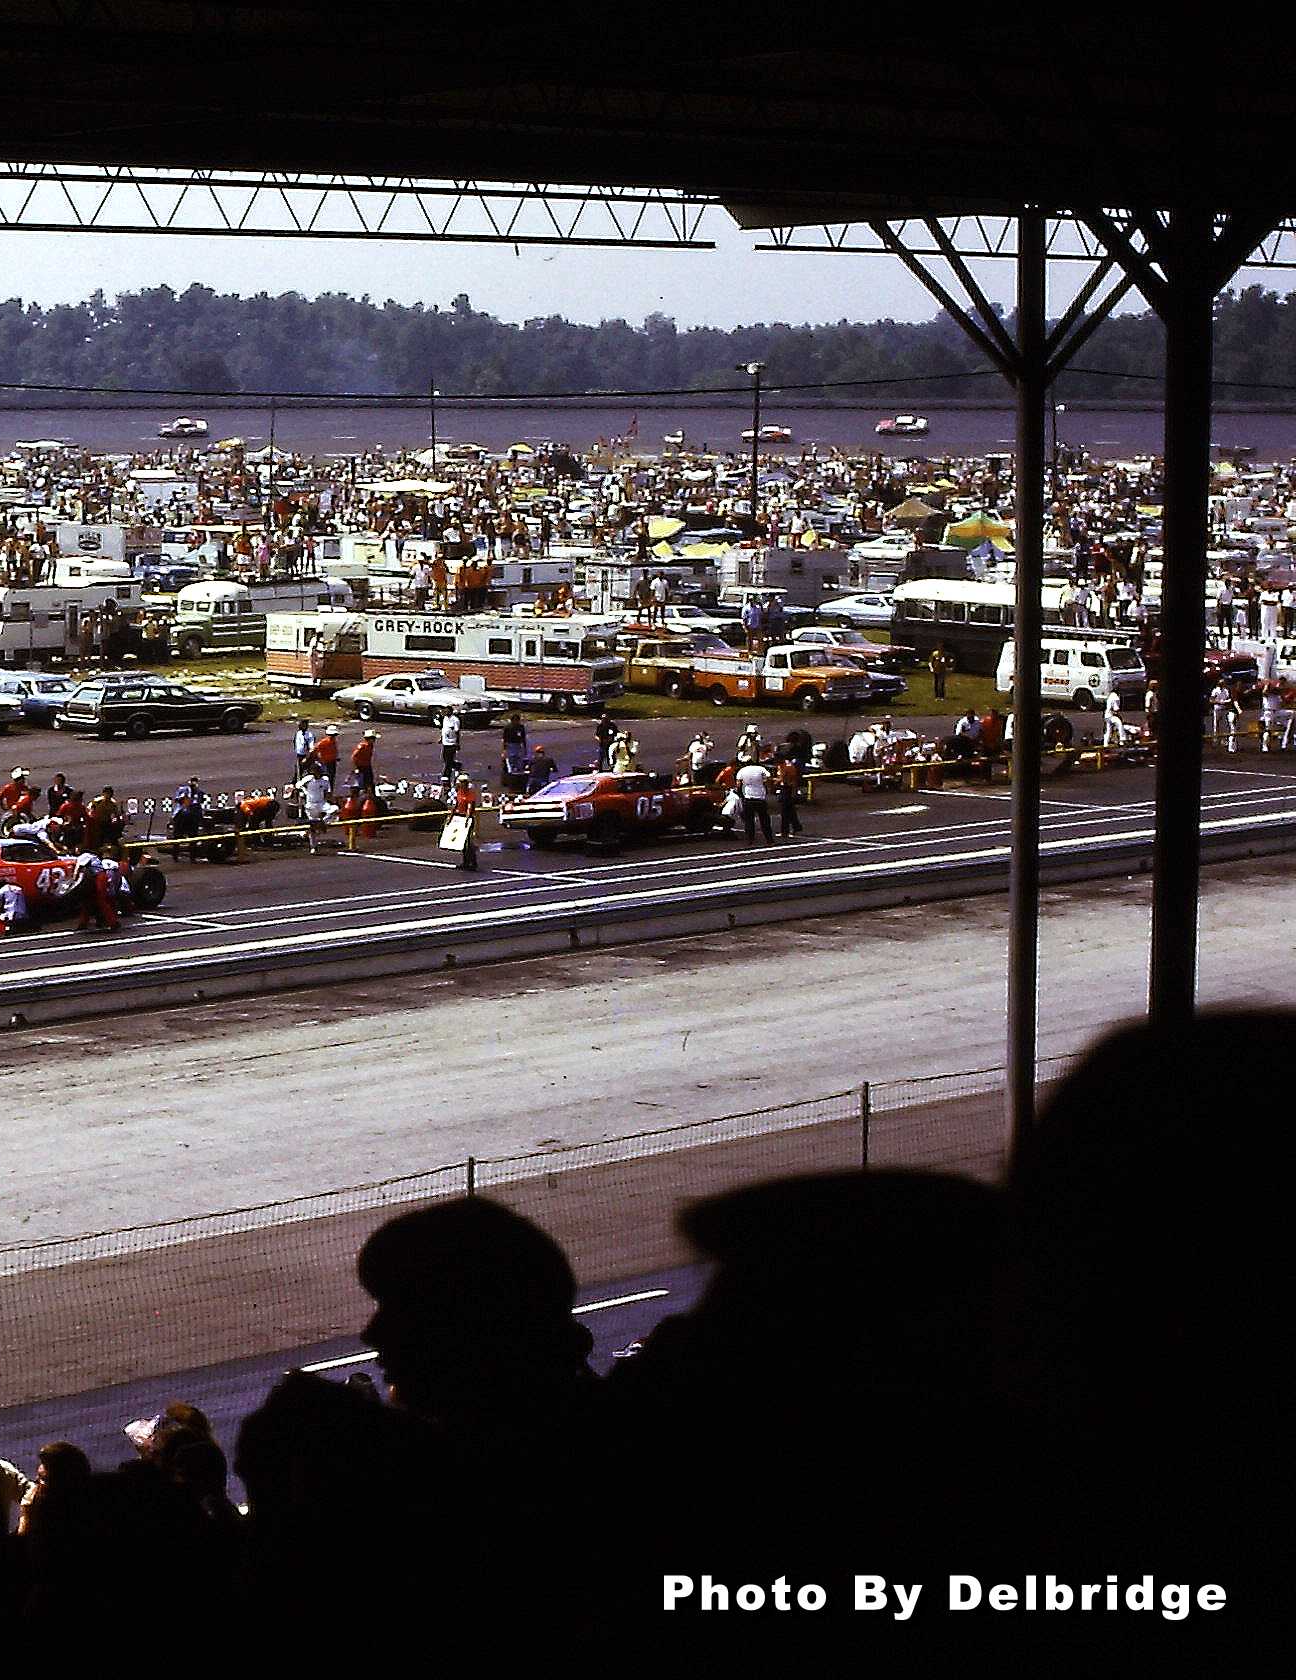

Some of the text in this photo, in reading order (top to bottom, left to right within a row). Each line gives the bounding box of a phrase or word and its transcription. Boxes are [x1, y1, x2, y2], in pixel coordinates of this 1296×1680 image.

[374, 619, 464, 634] GREY-ROCK
[635, 794, 664, 819] 05
[36, 867, 66, 896] 43
